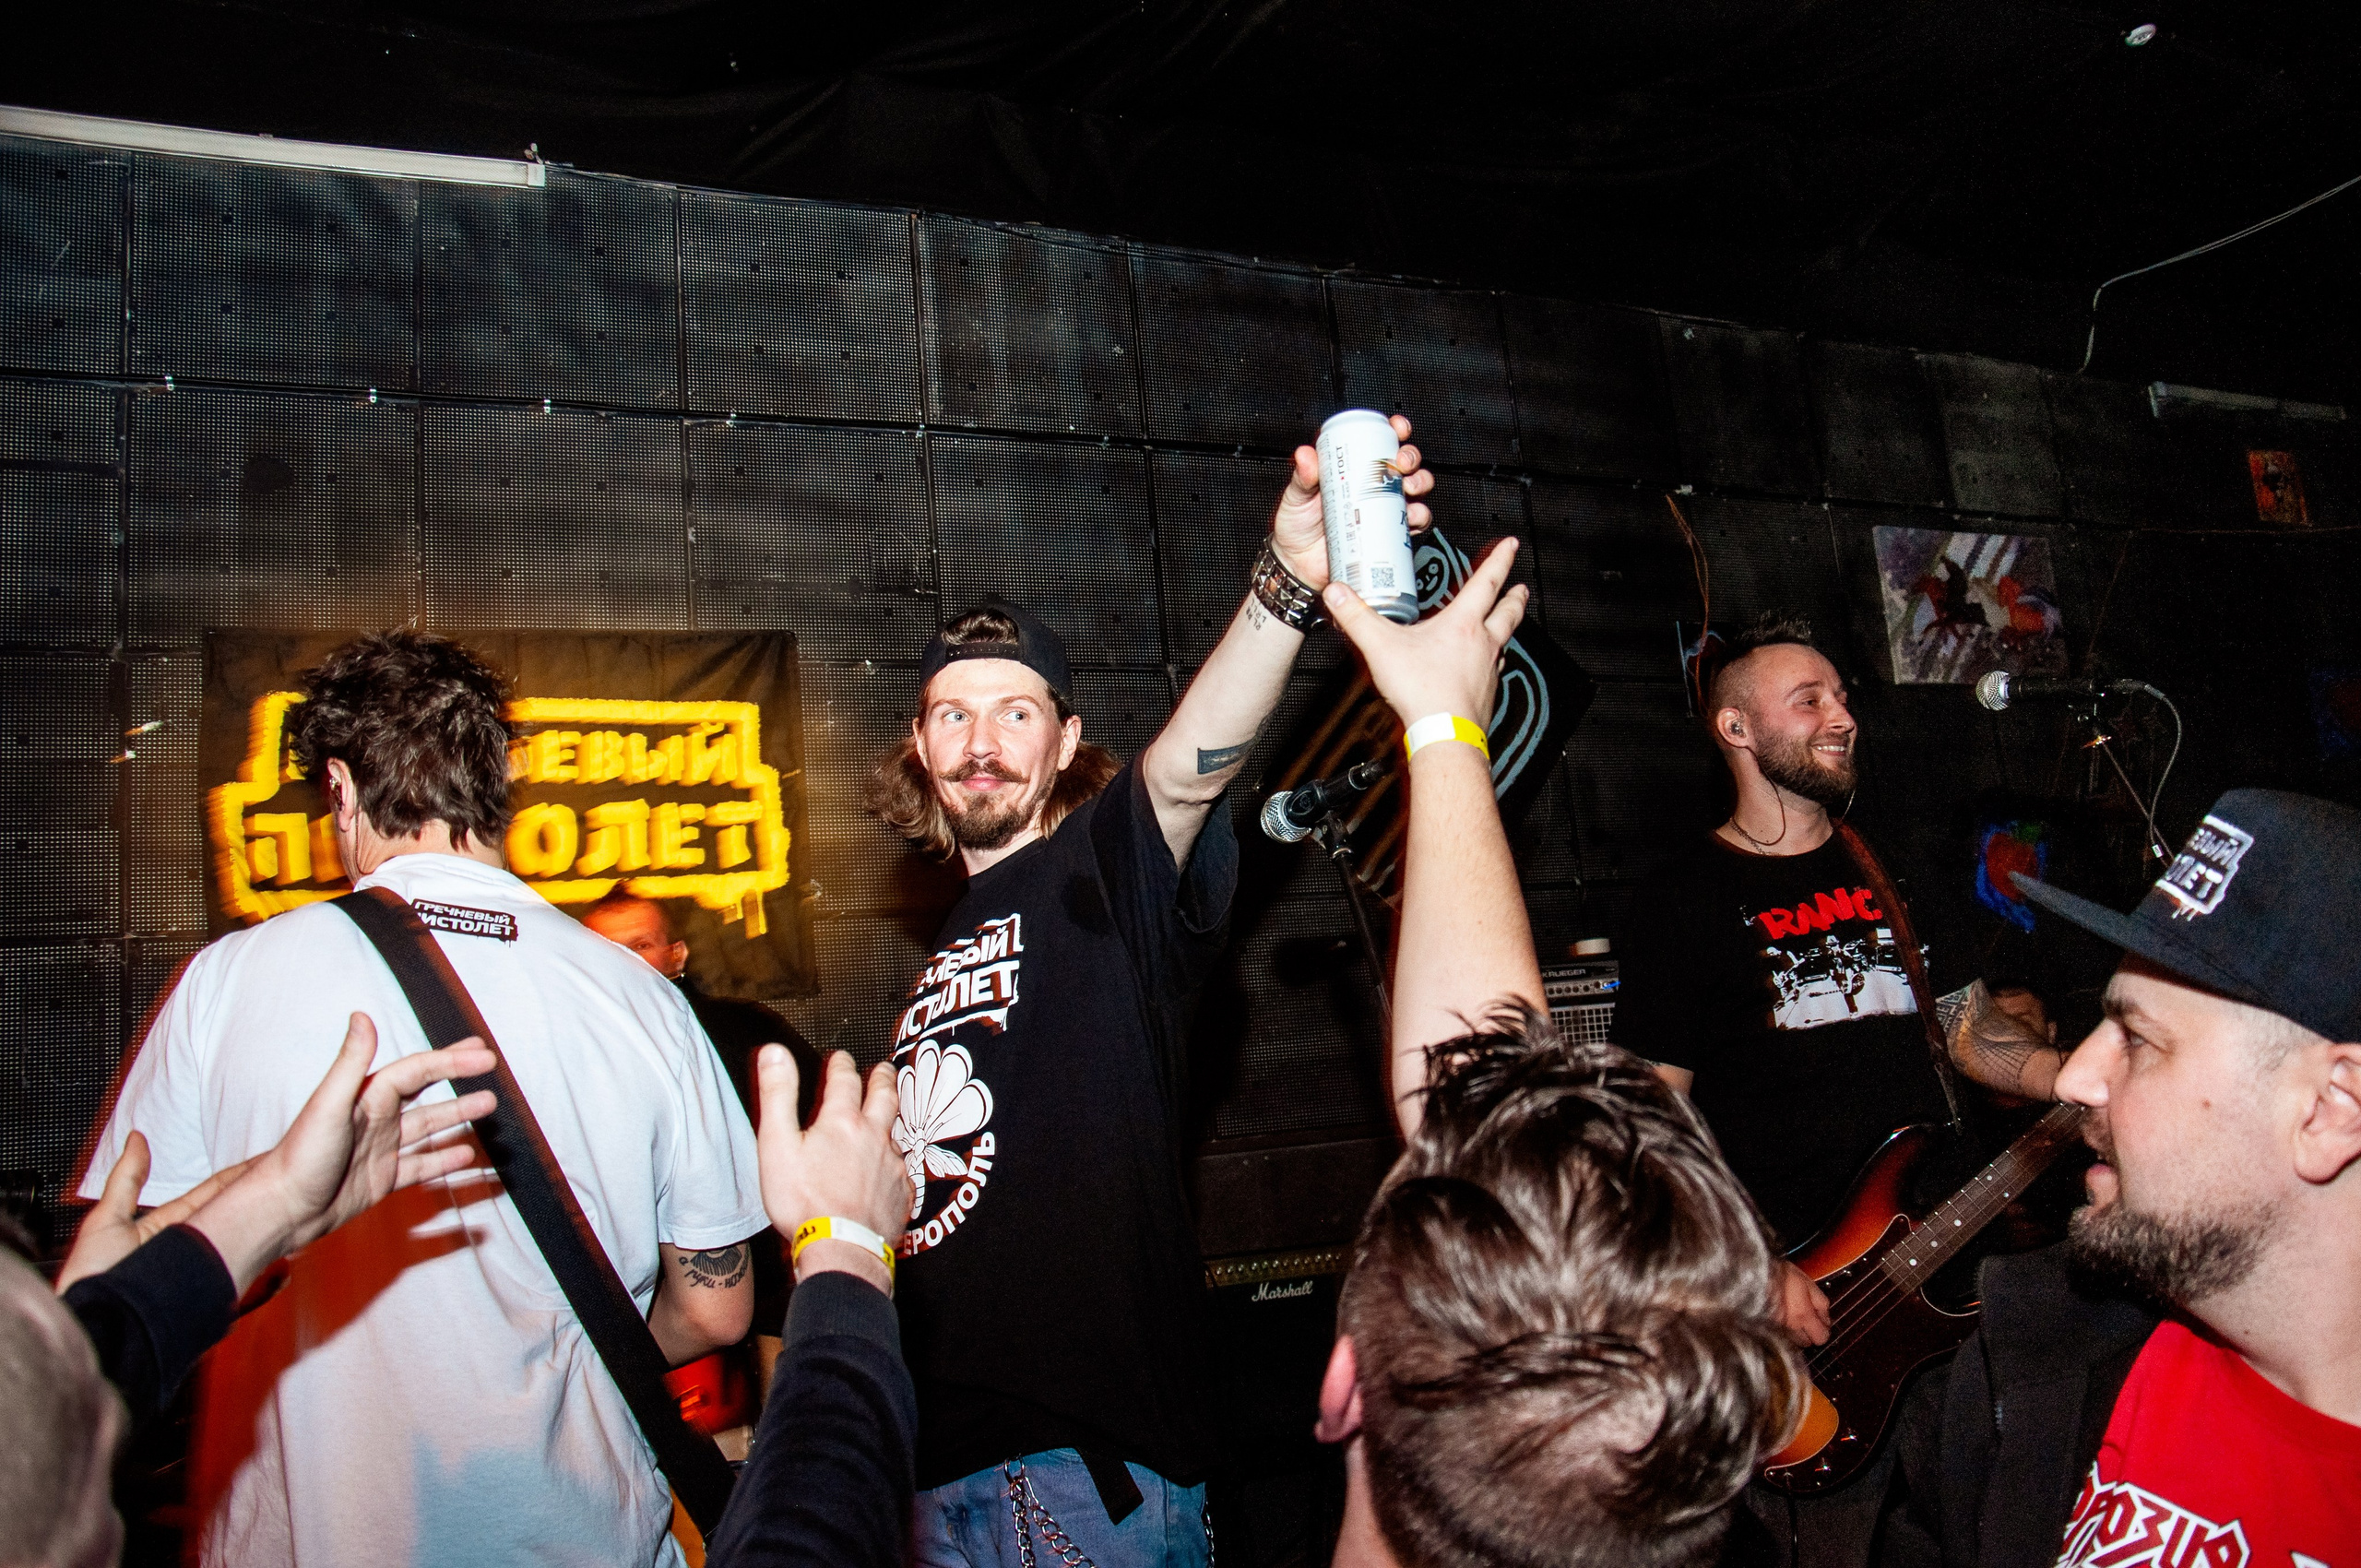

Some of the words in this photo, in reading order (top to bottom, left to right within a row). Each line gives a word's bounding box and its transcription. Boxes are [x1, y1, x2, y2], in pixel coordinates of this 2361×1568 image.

[414, 901, 511, 925] ГРЕЧНЕВЫЙ
[418, 912, 515, 936] ИСТОЛЕТ
[1758, 887, 1883, 940] RANC
[903, 1131, 996, 1256] ЕРОПОЛЬ
[1251, 1280, 1314, 1302] Marshall
